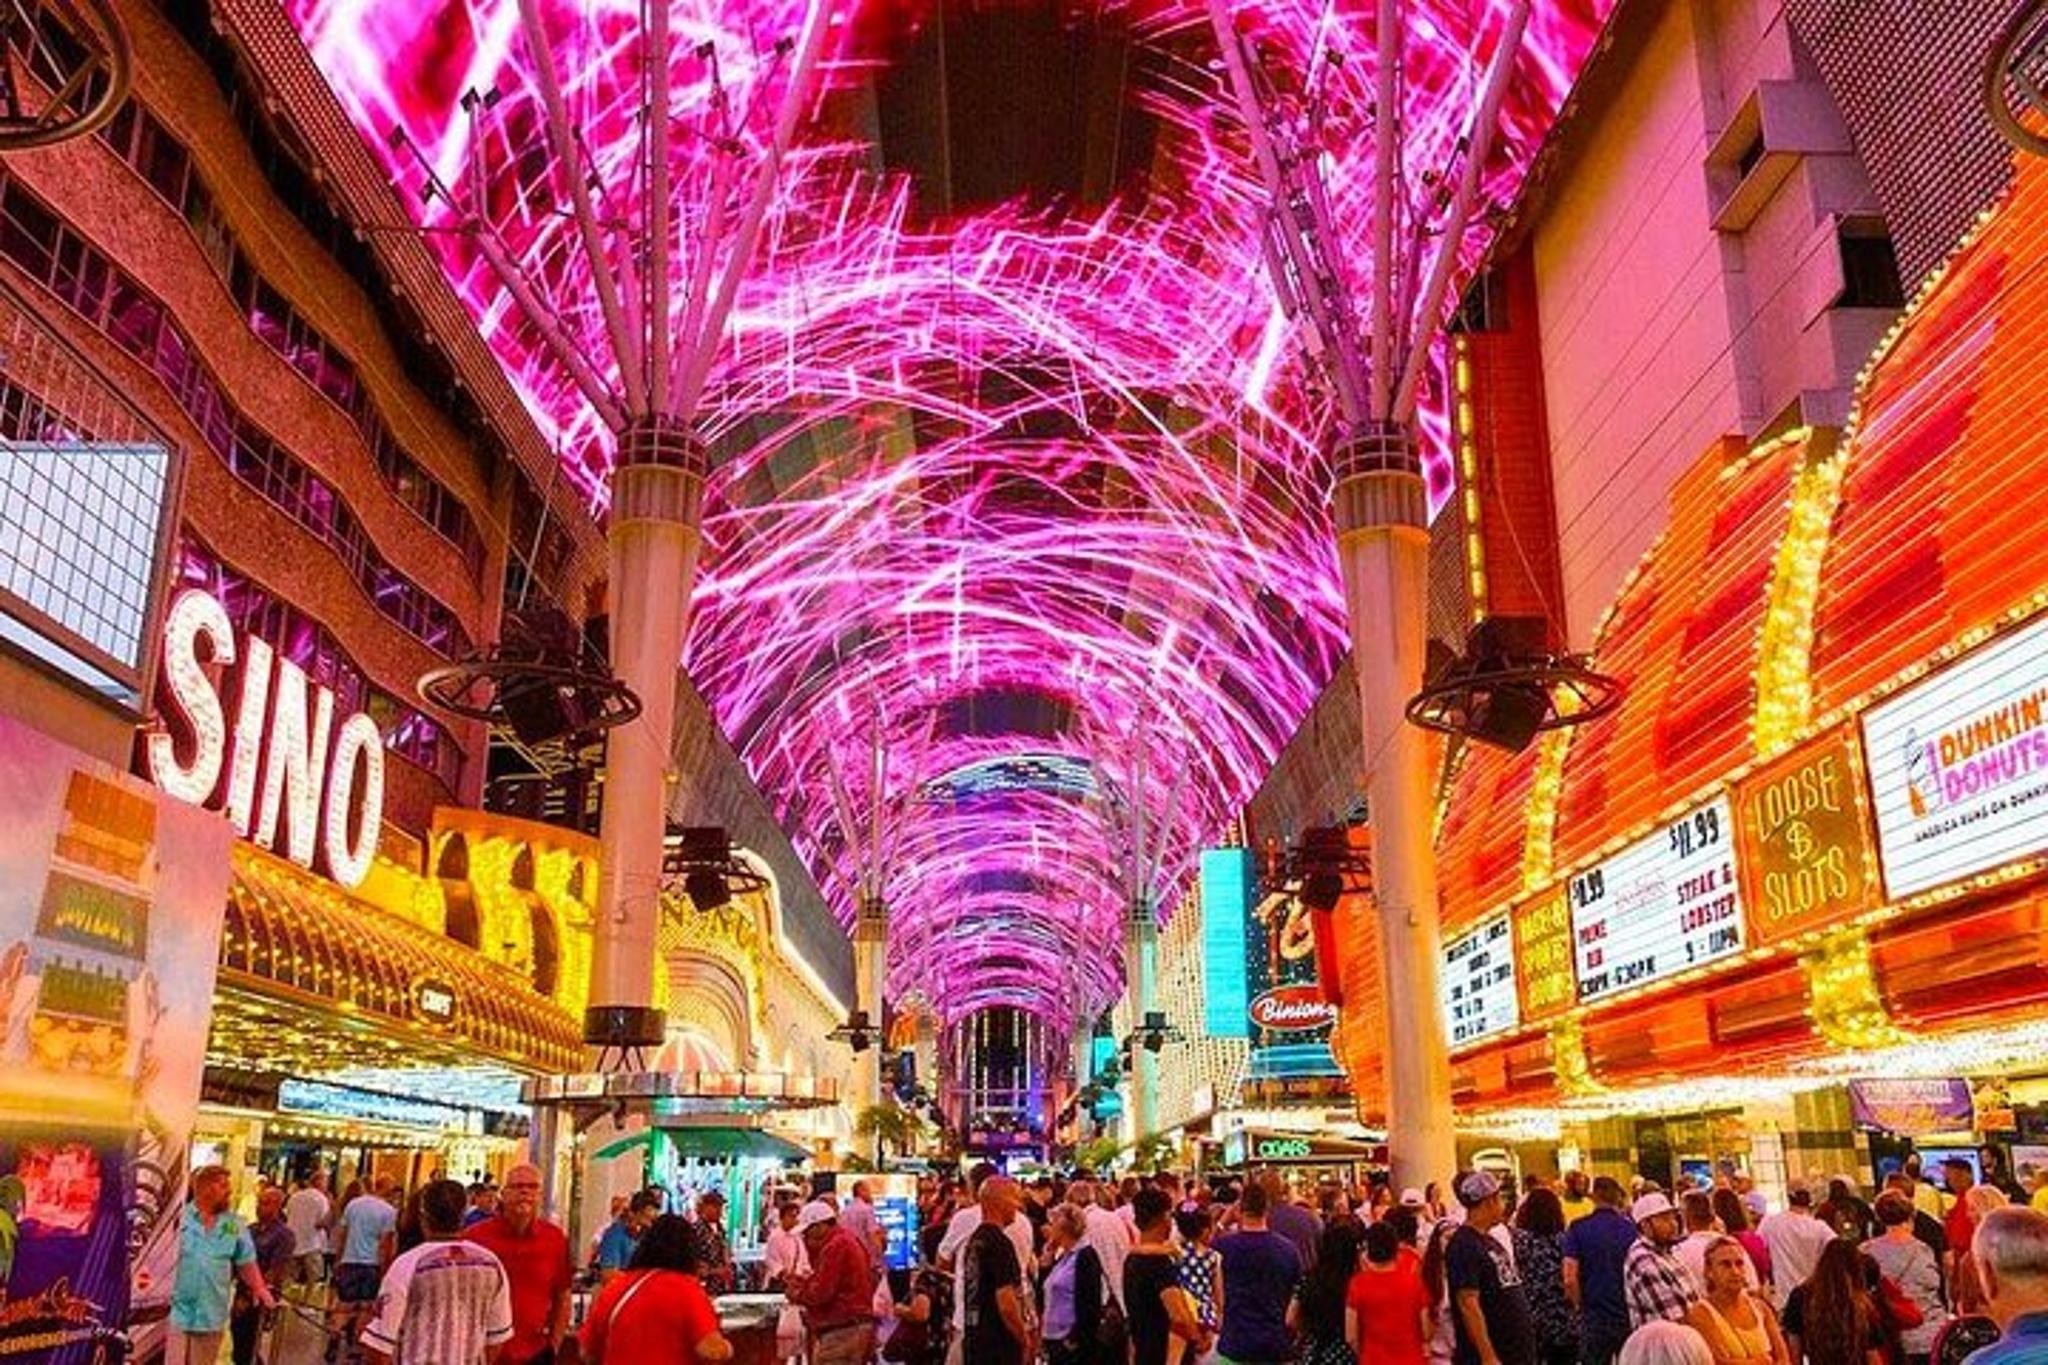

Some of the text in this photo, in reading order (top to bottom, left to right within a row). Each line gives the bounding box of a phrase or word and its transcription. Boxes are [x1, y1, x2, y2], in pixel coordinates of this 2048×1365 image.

[149, 588, 384, 888] SINO
[1945, 730, 2048, 803] DONUTS
[1756, 755, 1840, 842] LOOSE
[1960, 804, 1989, 826] RUNS
[1991, 799, 2006, 815] ON
[1678, 869, 1716, 905] STEAK
[1681, 893, 1736, 933] LOBSTER
[1766, 846, 1847, 920] SLOTS
